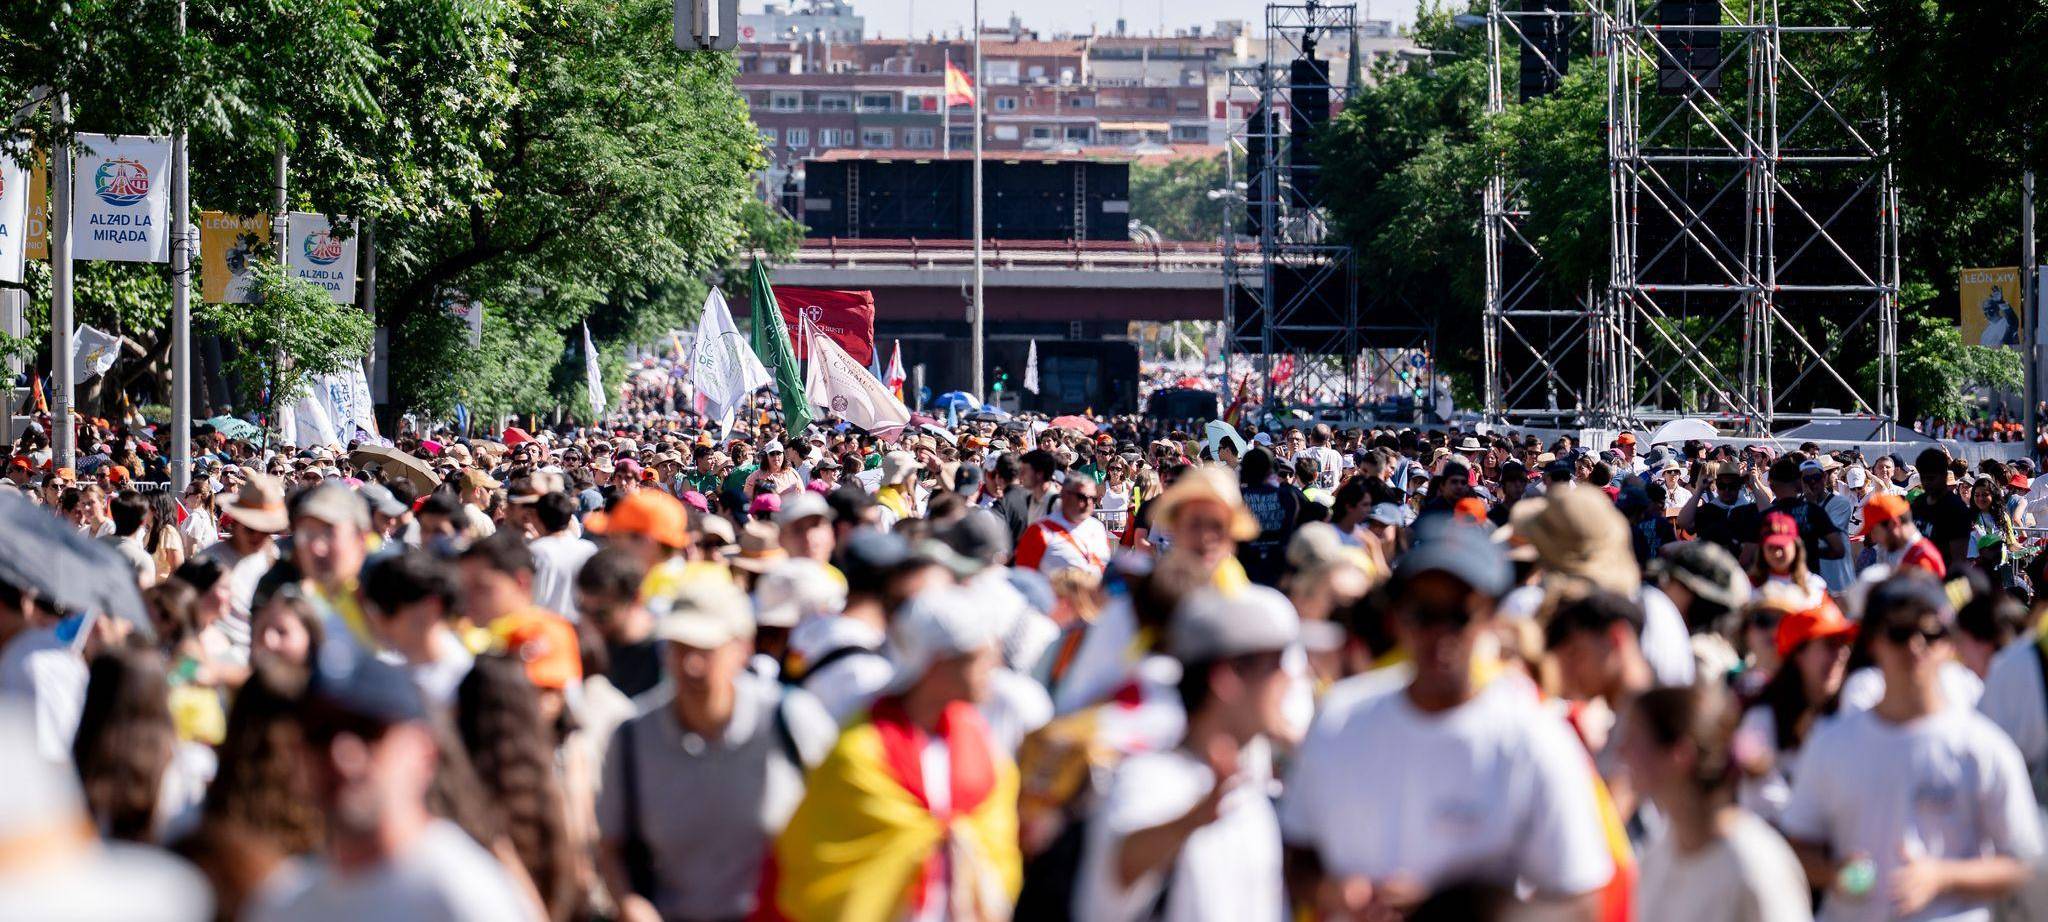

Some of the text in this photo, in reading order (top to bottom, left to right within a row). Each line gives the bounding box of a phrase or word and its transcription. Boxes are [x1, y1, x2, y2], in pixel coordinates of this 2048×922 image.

[90, 213, 152, 227] ALZAD LA
[206, 215, 239, 230] LEÓN
[94, 229, 147, 243] MIRADA
[299, 269, 344, 280] ALZAD LA
